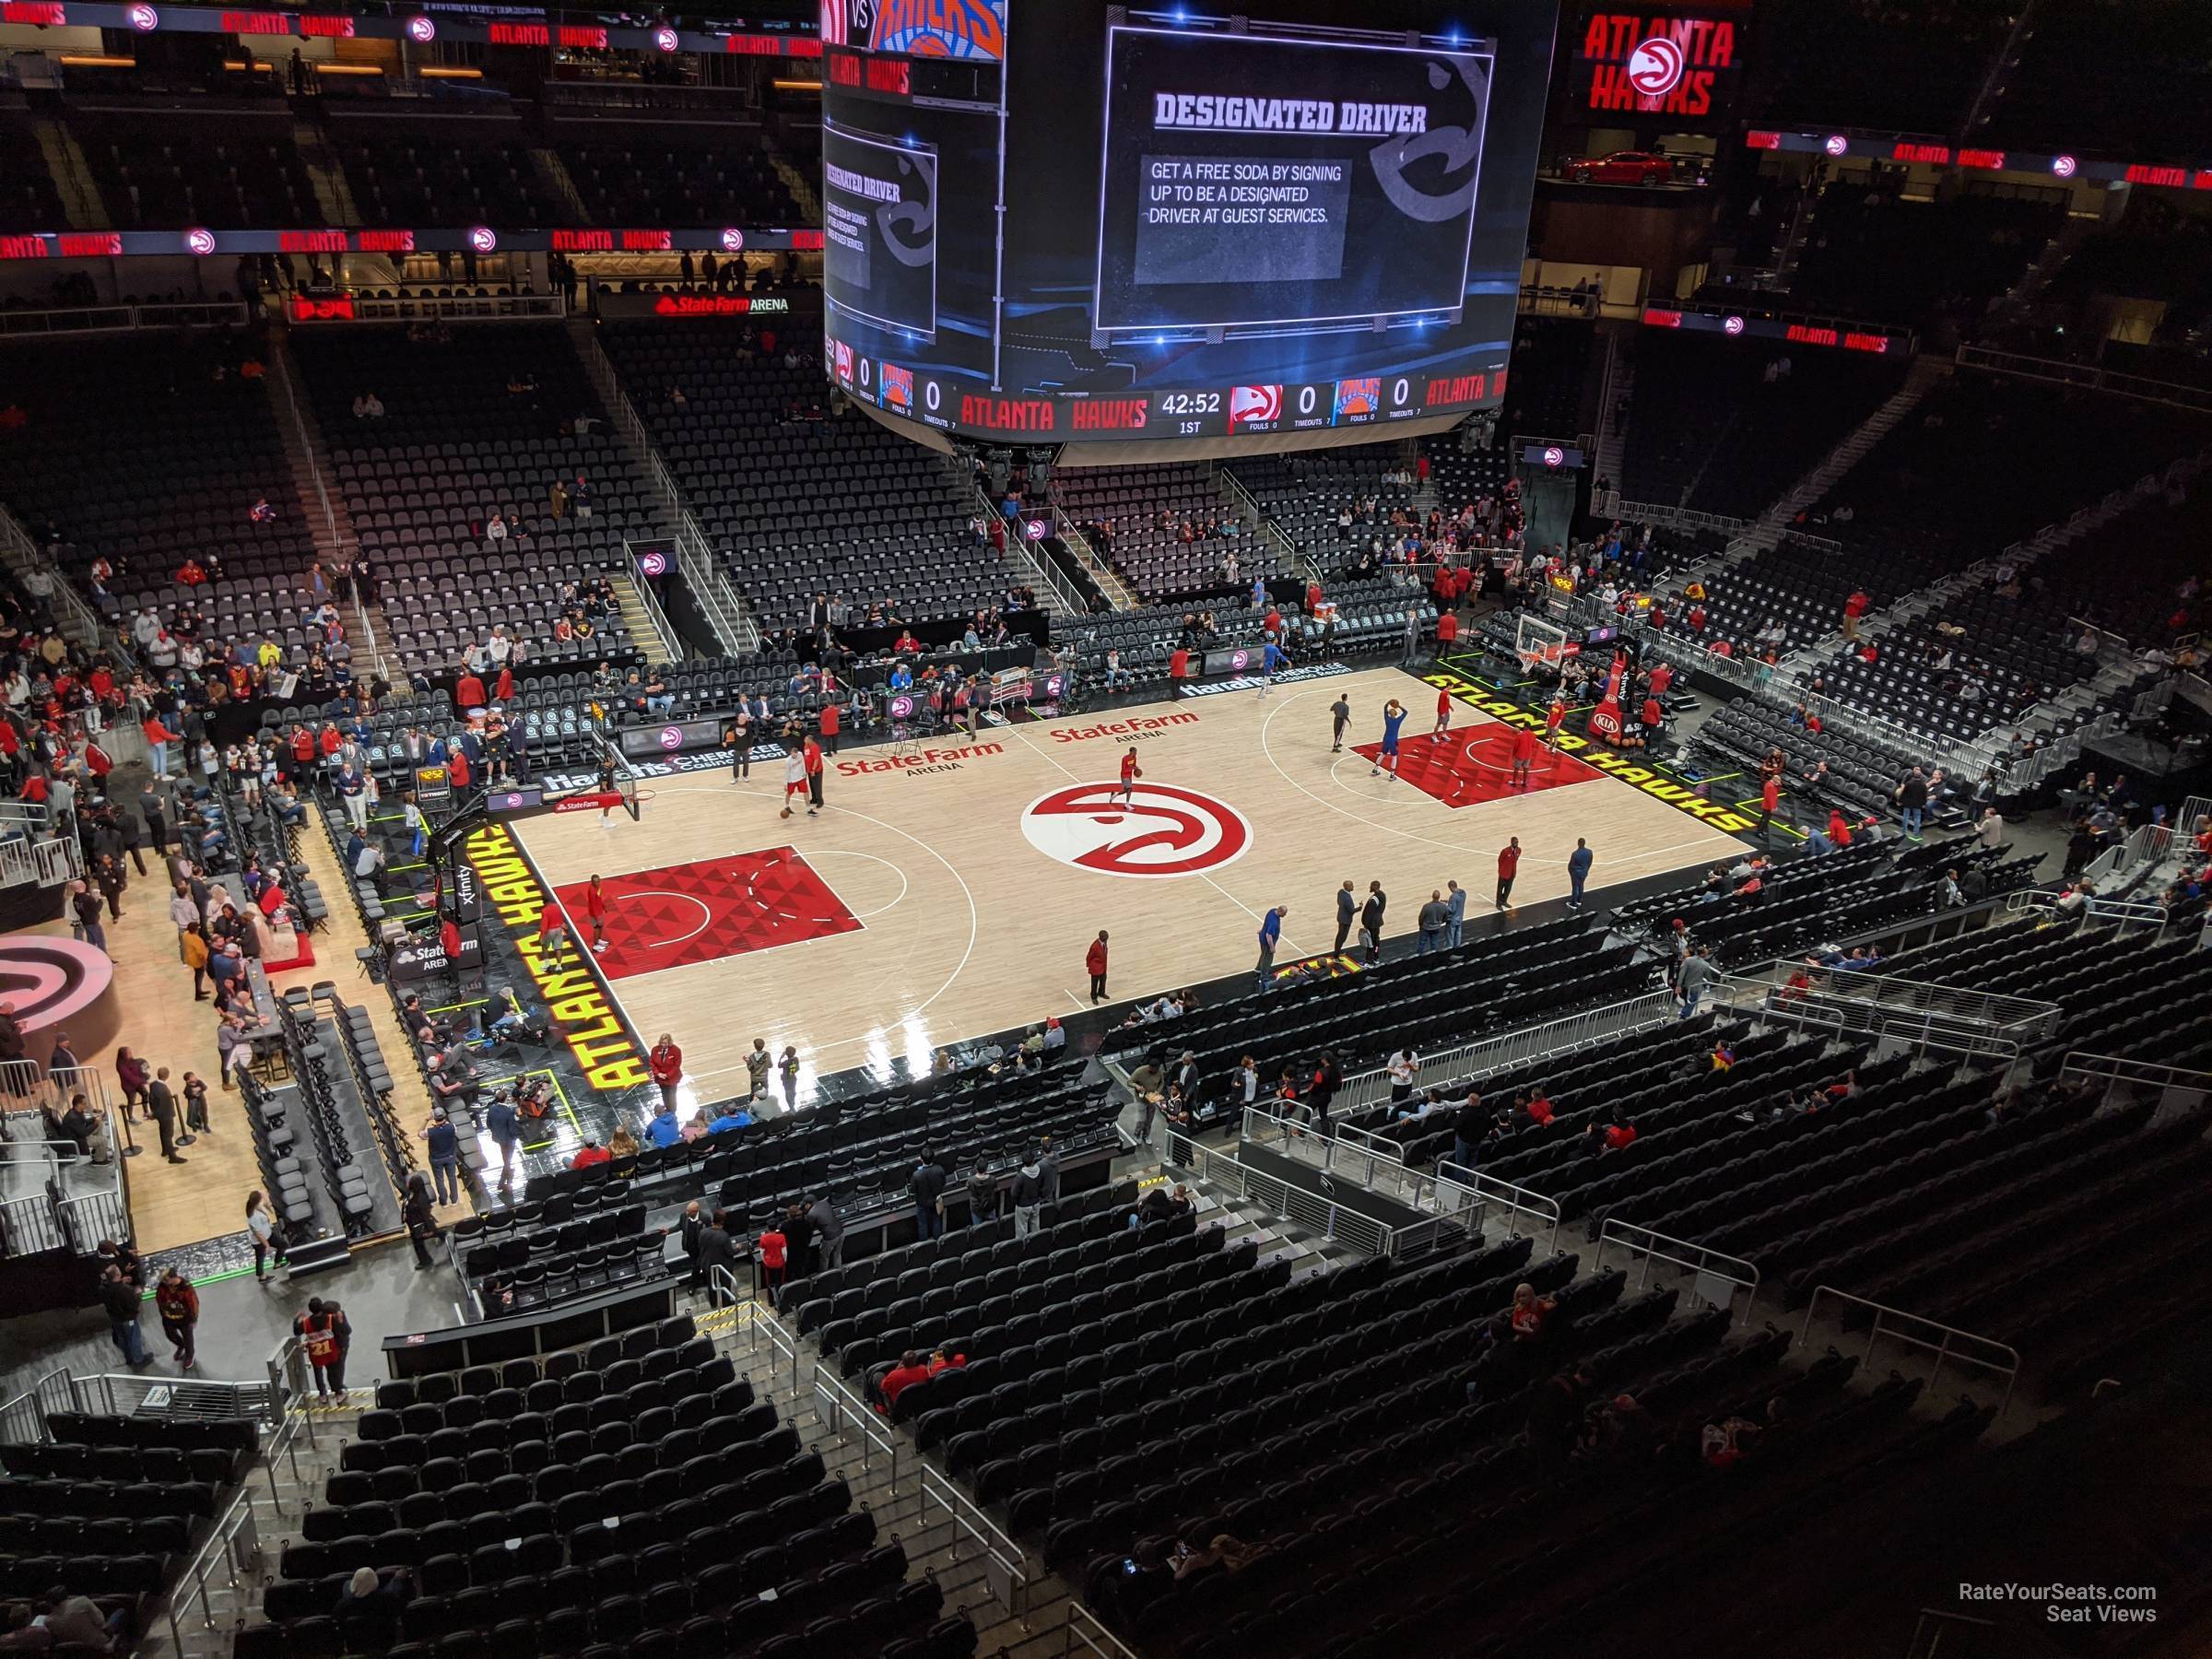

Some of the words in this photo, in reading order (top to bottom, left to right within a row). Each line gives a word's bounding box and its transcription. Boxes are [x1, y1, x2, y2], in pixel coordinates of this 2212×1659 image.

[222, 12, 288, 34] ATLANTA
[300, 16, 354, 37] HAWKS
[852, 0, 867, 29] VS
[490, 24, 549, 44] ATLANTA
[559, 27, 607, 47] HAWKS
[727, 36, 780, 53] ATLANTA
[1157, 93, 1334, 131] DESIGNATED
[1340, 102, 1427, 134] DRIVER
[1894, 144, 1949, 164] ATLANTA
[1957, 148, 2004, 169] HAWKS
[1151, 162, 1180, 180] GET
[1182, 163, 1194, 180] A
[1196, 164, 1231, 181] FREE
[1234, 165, 1269, 181] SODA
[1272, 166, 1289, 181] BY
[1291, 167, 1342, 182] SIGNING
[2125, 164, 2186, 187] ATLANTA
[864, 176, 900, 203] DRIVER
[1151, 185, 1171, 201] UP
[1174, 185, 1194, 202] TO
[1197, 186, 1215, 202] BE
[1218, 187, 1228, 202] A
[1230, 186, 1309, 203] DESIGNATED
[1149, 208, 1200, 223] DRIVER
[1203, 208, 1220, 223] AT
[1222, 208, 1266, 223] GUEST
[1268, 208, 1328, 223] SERVICES.
[281, 232, 347, 252] ATLANTA
[359, 231, 414, 251] HAWKS
[554, 231, 613, 250] ATLANTA
[622, 230, 671, 250] HAWKS
[749, 299, 788, 312] ARENA
[1787, 324, 1837, 346] ATLANTA
[1845, 333, 1888, 352] HAWKS
[860, 359, 869, 386] 0
[926, 382, 940, 410] 0
[1299, 386, 1315, 414] 0
[1394, 378, 1408, 406] 0
[1427, 374, 1484, 406] ATLANTA
[891, 404, 905, 416] FOULS
[907, 408, 912, 417] 0
[961, 395, 1053, 430] ATLANTA
[1073, 400, 1147, 429] HAWKS
[1162, 393, 1220, 414] 42:52
[1390, 410, 1414, 418] TIMEOUTS
[924, 415, 948, 428] TIMEOUTS
[951, 421, 957, 429] 7
[1180, 421, 1201, 433] 1ST
[1295, 418, 1323, 427] TIMEOUTS
[1316, 667, 1354, 677] Resort
[1618, 671, 1630, 700] xfinity
[1596, 715, 1615, 731] KIA
[1115, 729, 1167, 744] ARENA
[421, 770, 443, 780] 42:52
[545, 762, 672, 791] Harah's
[740, 748, 788, 760] esort
[906, 762, 965, 777] ARENA
[1583, 752, 1758, 832] HAWKS
[459, 865, 473, 905] xfinity
[312, 1341, 332, 1356] 21
